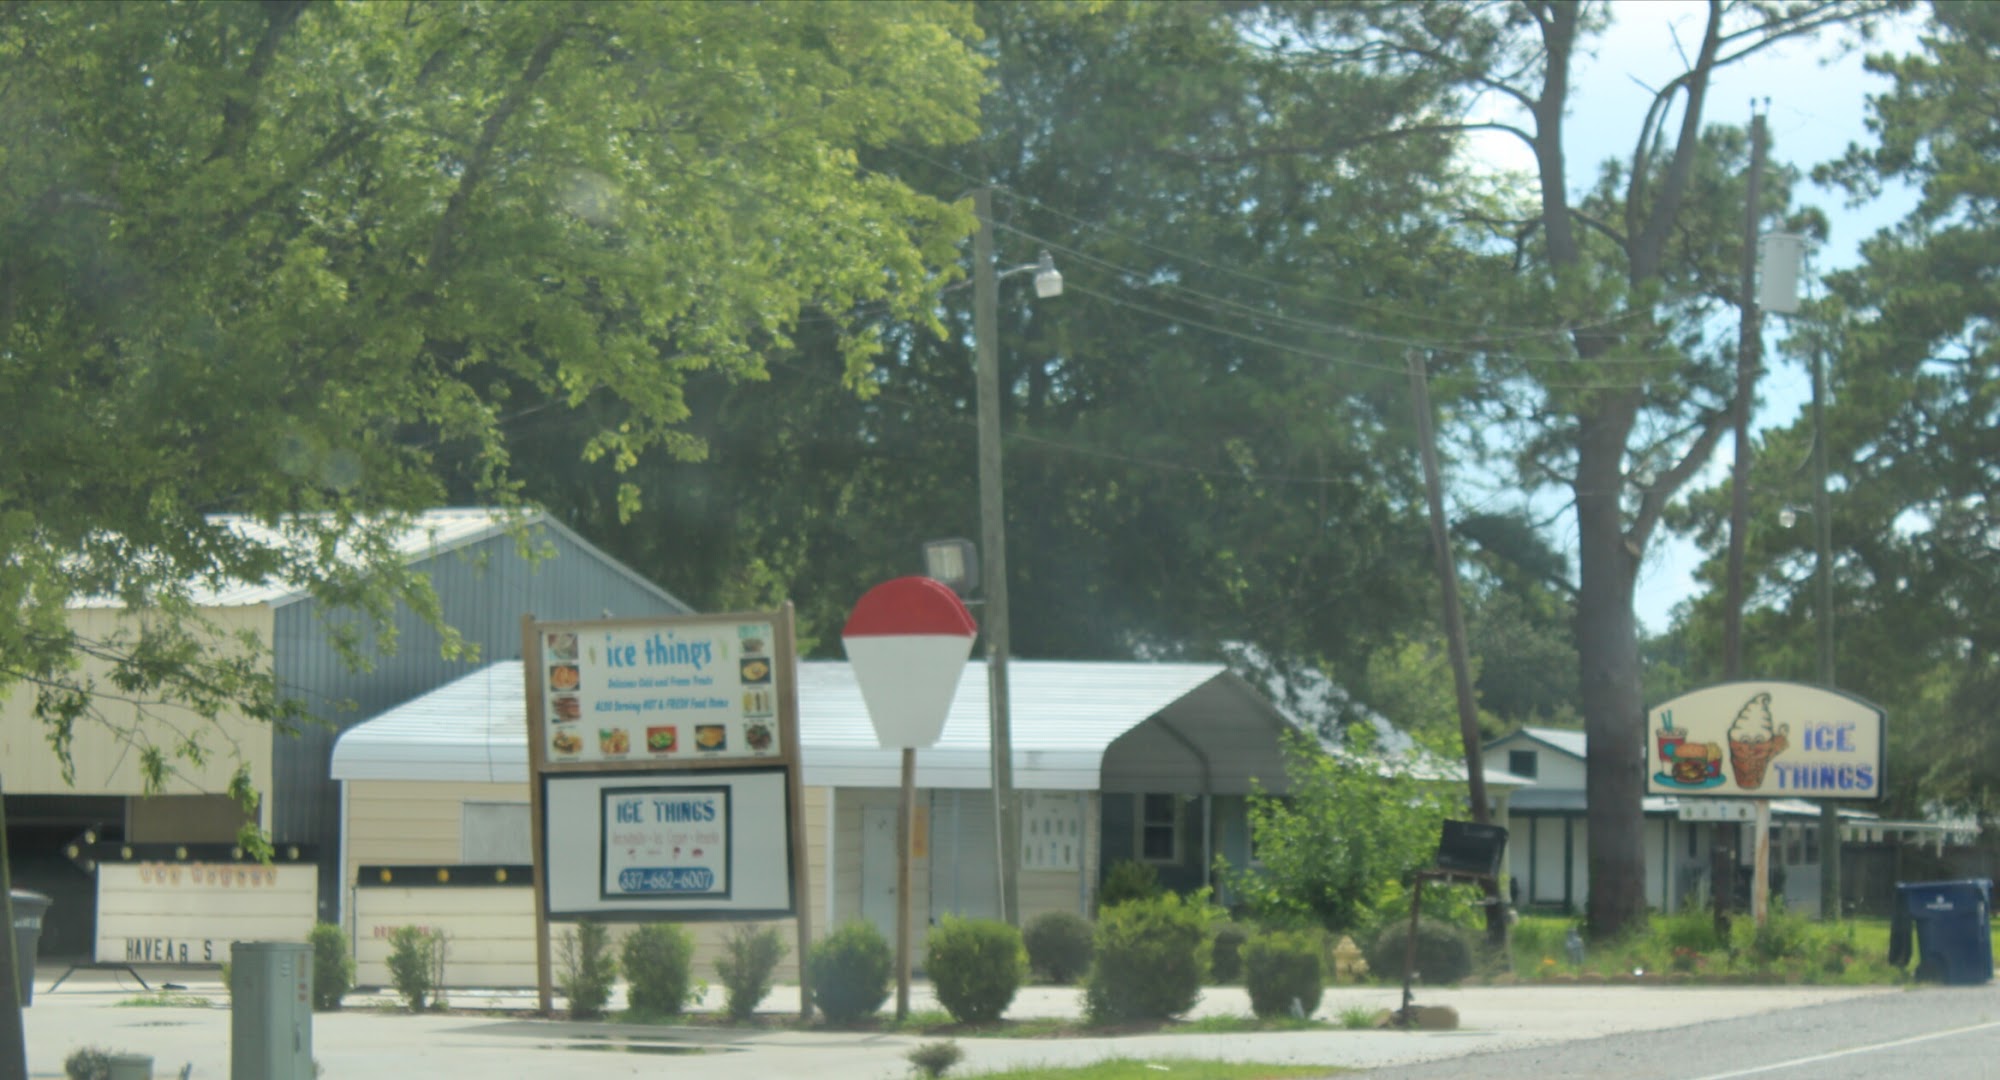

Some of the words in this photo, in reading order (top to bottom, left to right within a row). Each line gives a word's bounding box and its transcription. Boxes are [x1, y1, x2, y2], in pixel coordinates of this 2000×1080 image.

[606, 632, 637, 668] ice
[645, 632, 712, 670] things
[1803, 721, 1856, 752] ICE
[1773, 763, 1874, 790] THINGS
[617, 801, 643, 823] ICE
[653, 799, 715, 823] THINGS
[621, 870, 711, 889] 337-662-6007
